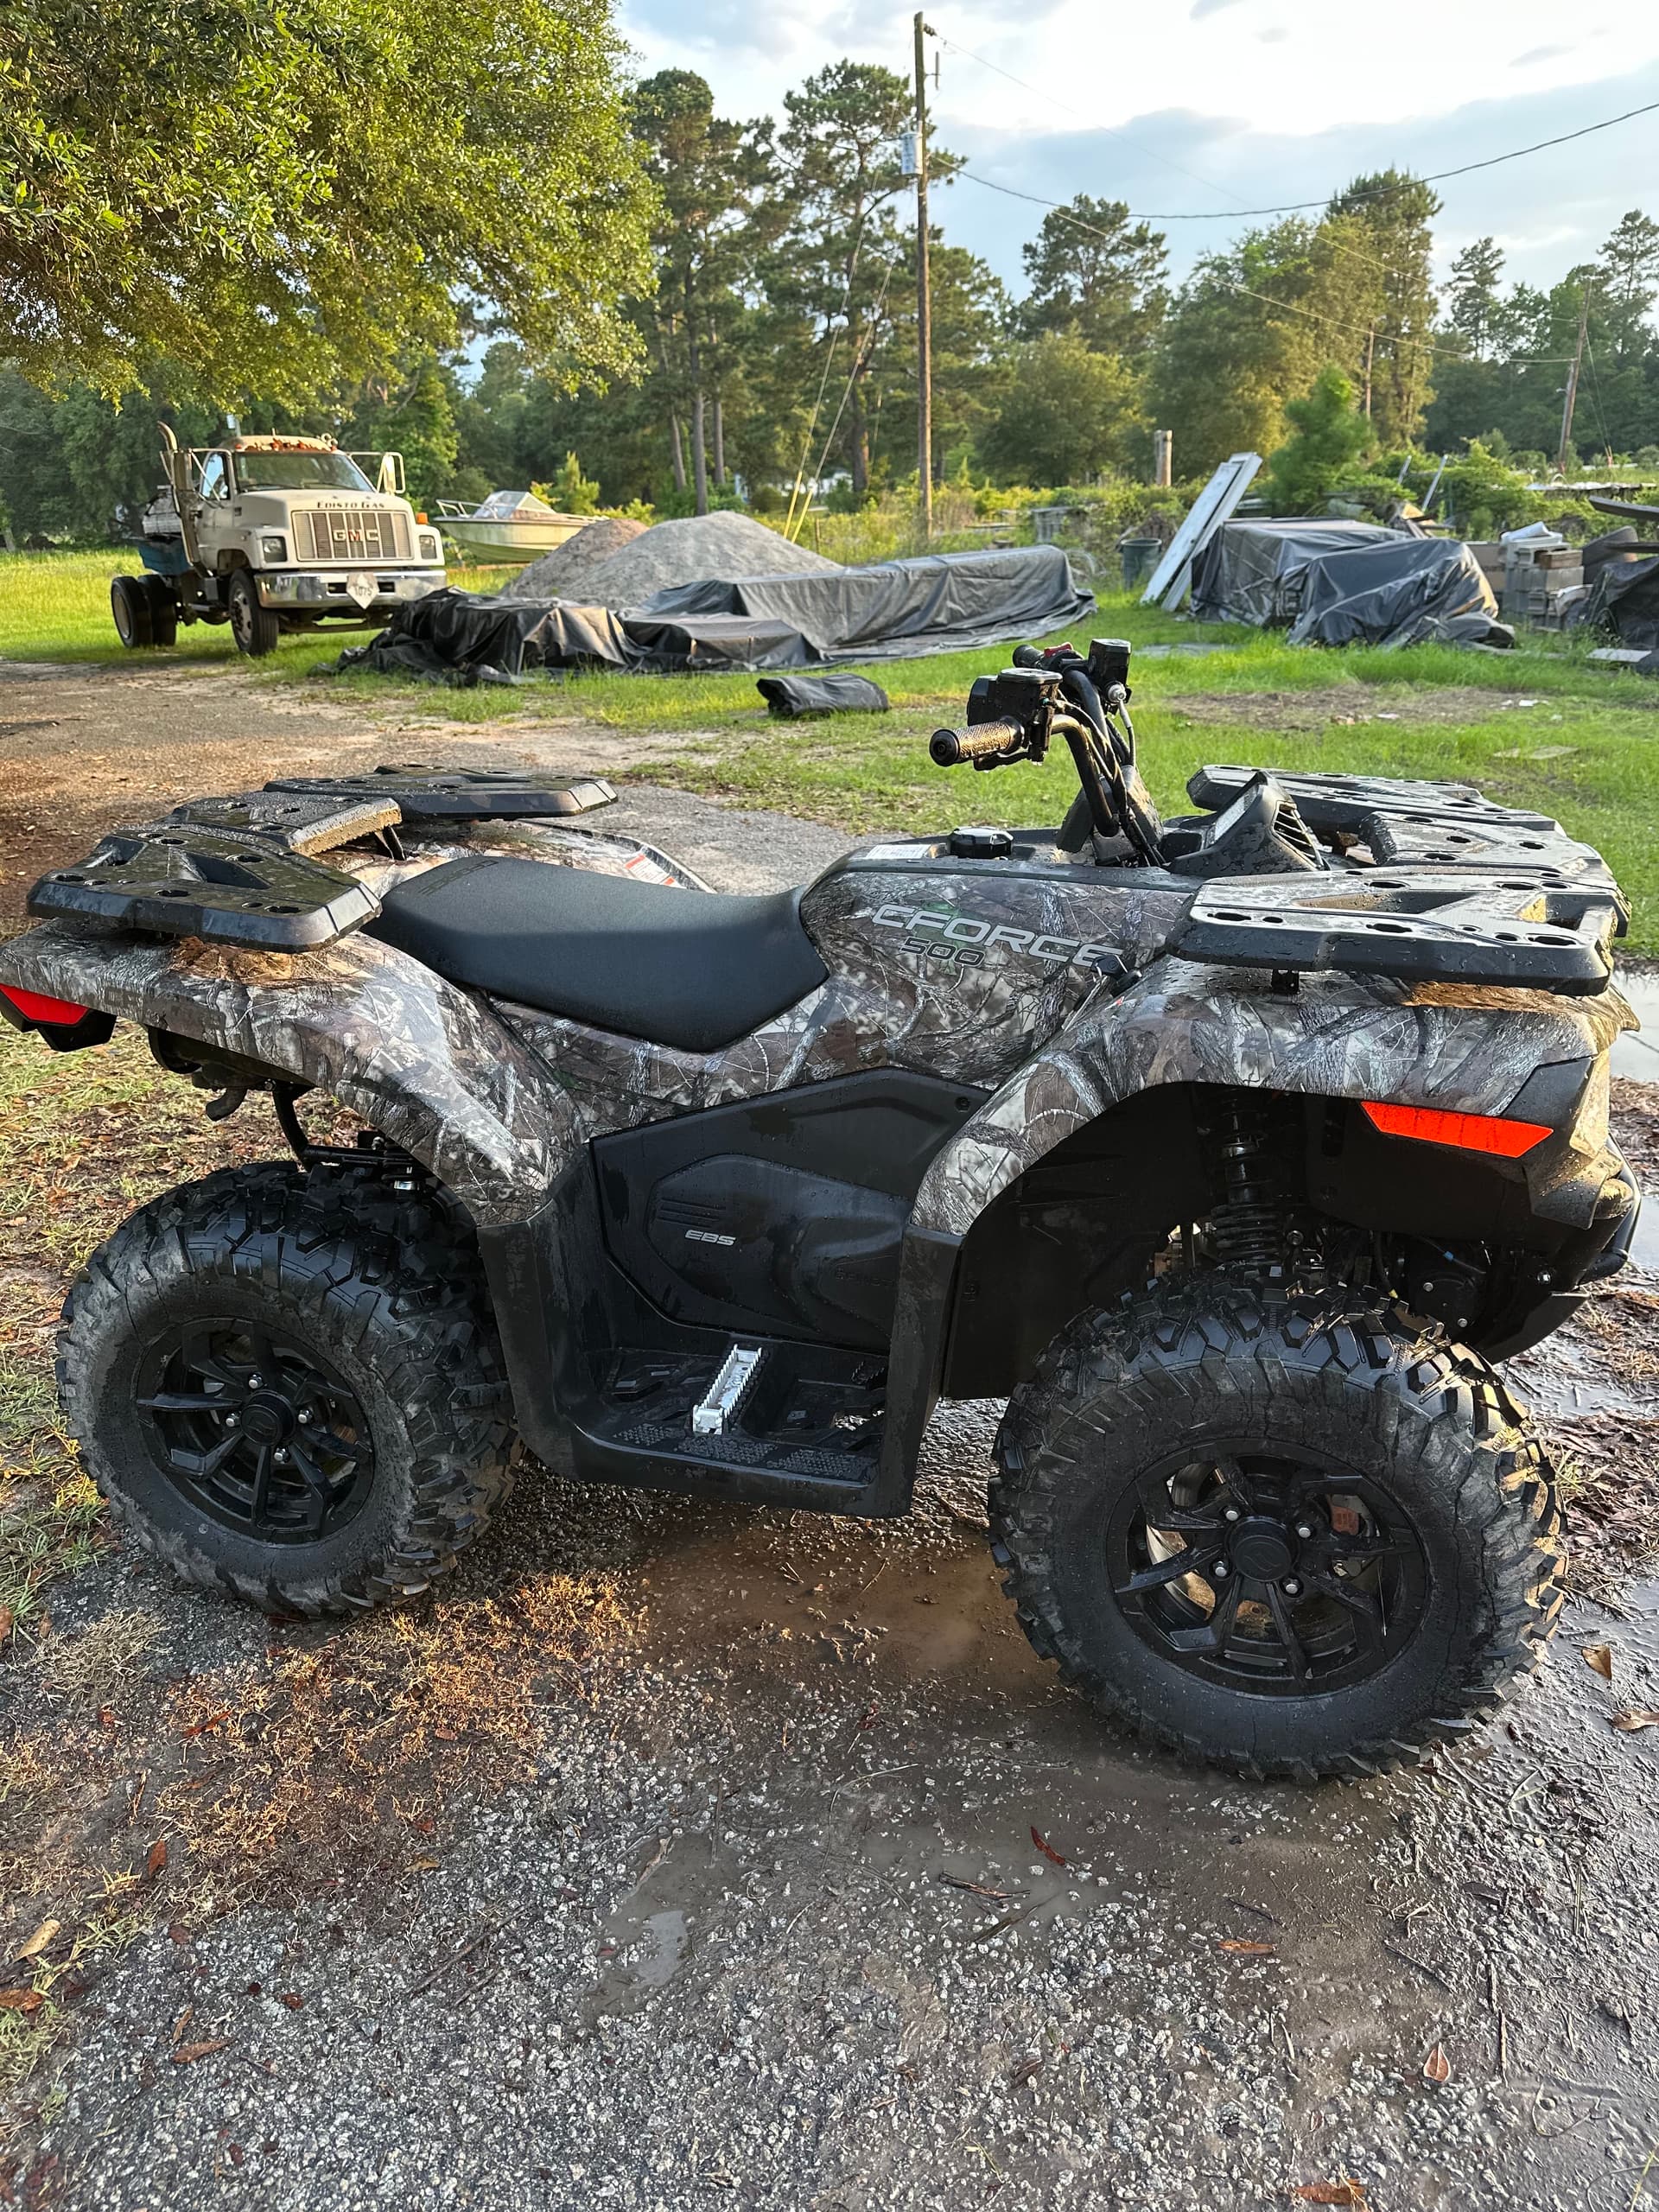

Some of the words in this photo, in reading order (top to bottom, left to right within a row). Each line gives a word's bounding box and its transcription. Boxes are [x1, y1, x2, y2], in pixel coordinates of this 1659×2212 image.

[333, 529, 378, 542] GMC
[871, 904, 1125, 968] CFORCE
[899, 937, 987, 969] 500
[685, 1230, 736, 1245] EBS
